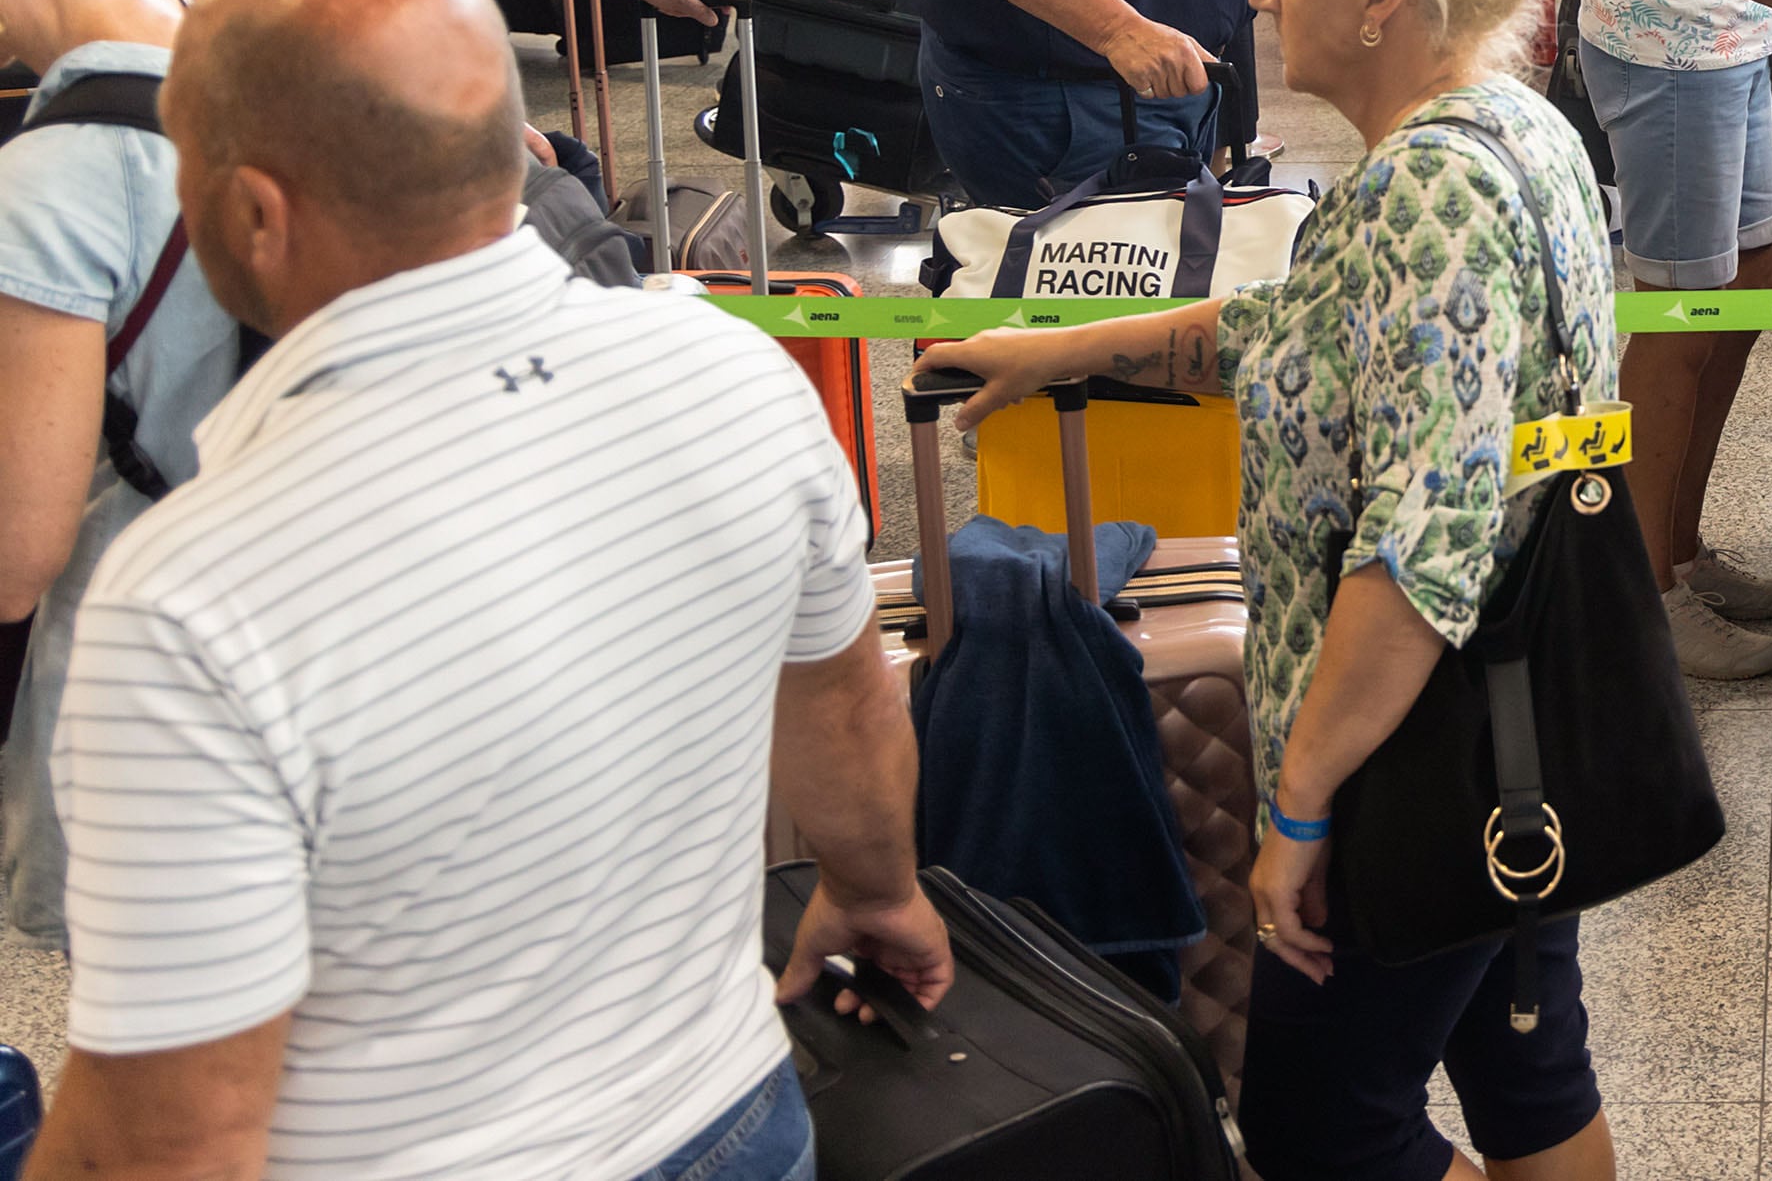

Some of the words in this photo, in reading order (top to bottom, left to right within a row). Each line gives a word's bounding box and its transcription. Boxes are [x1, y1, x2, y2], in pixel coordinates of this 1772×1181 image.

[1040, 242, 1168, 270] MARTINI
[1035, 270, 1161, 297] RACING
[810, 310, 840, 322] aena
[1690, 306, 1720, 317] aena
[1030, 313, 1060, 324] aena
